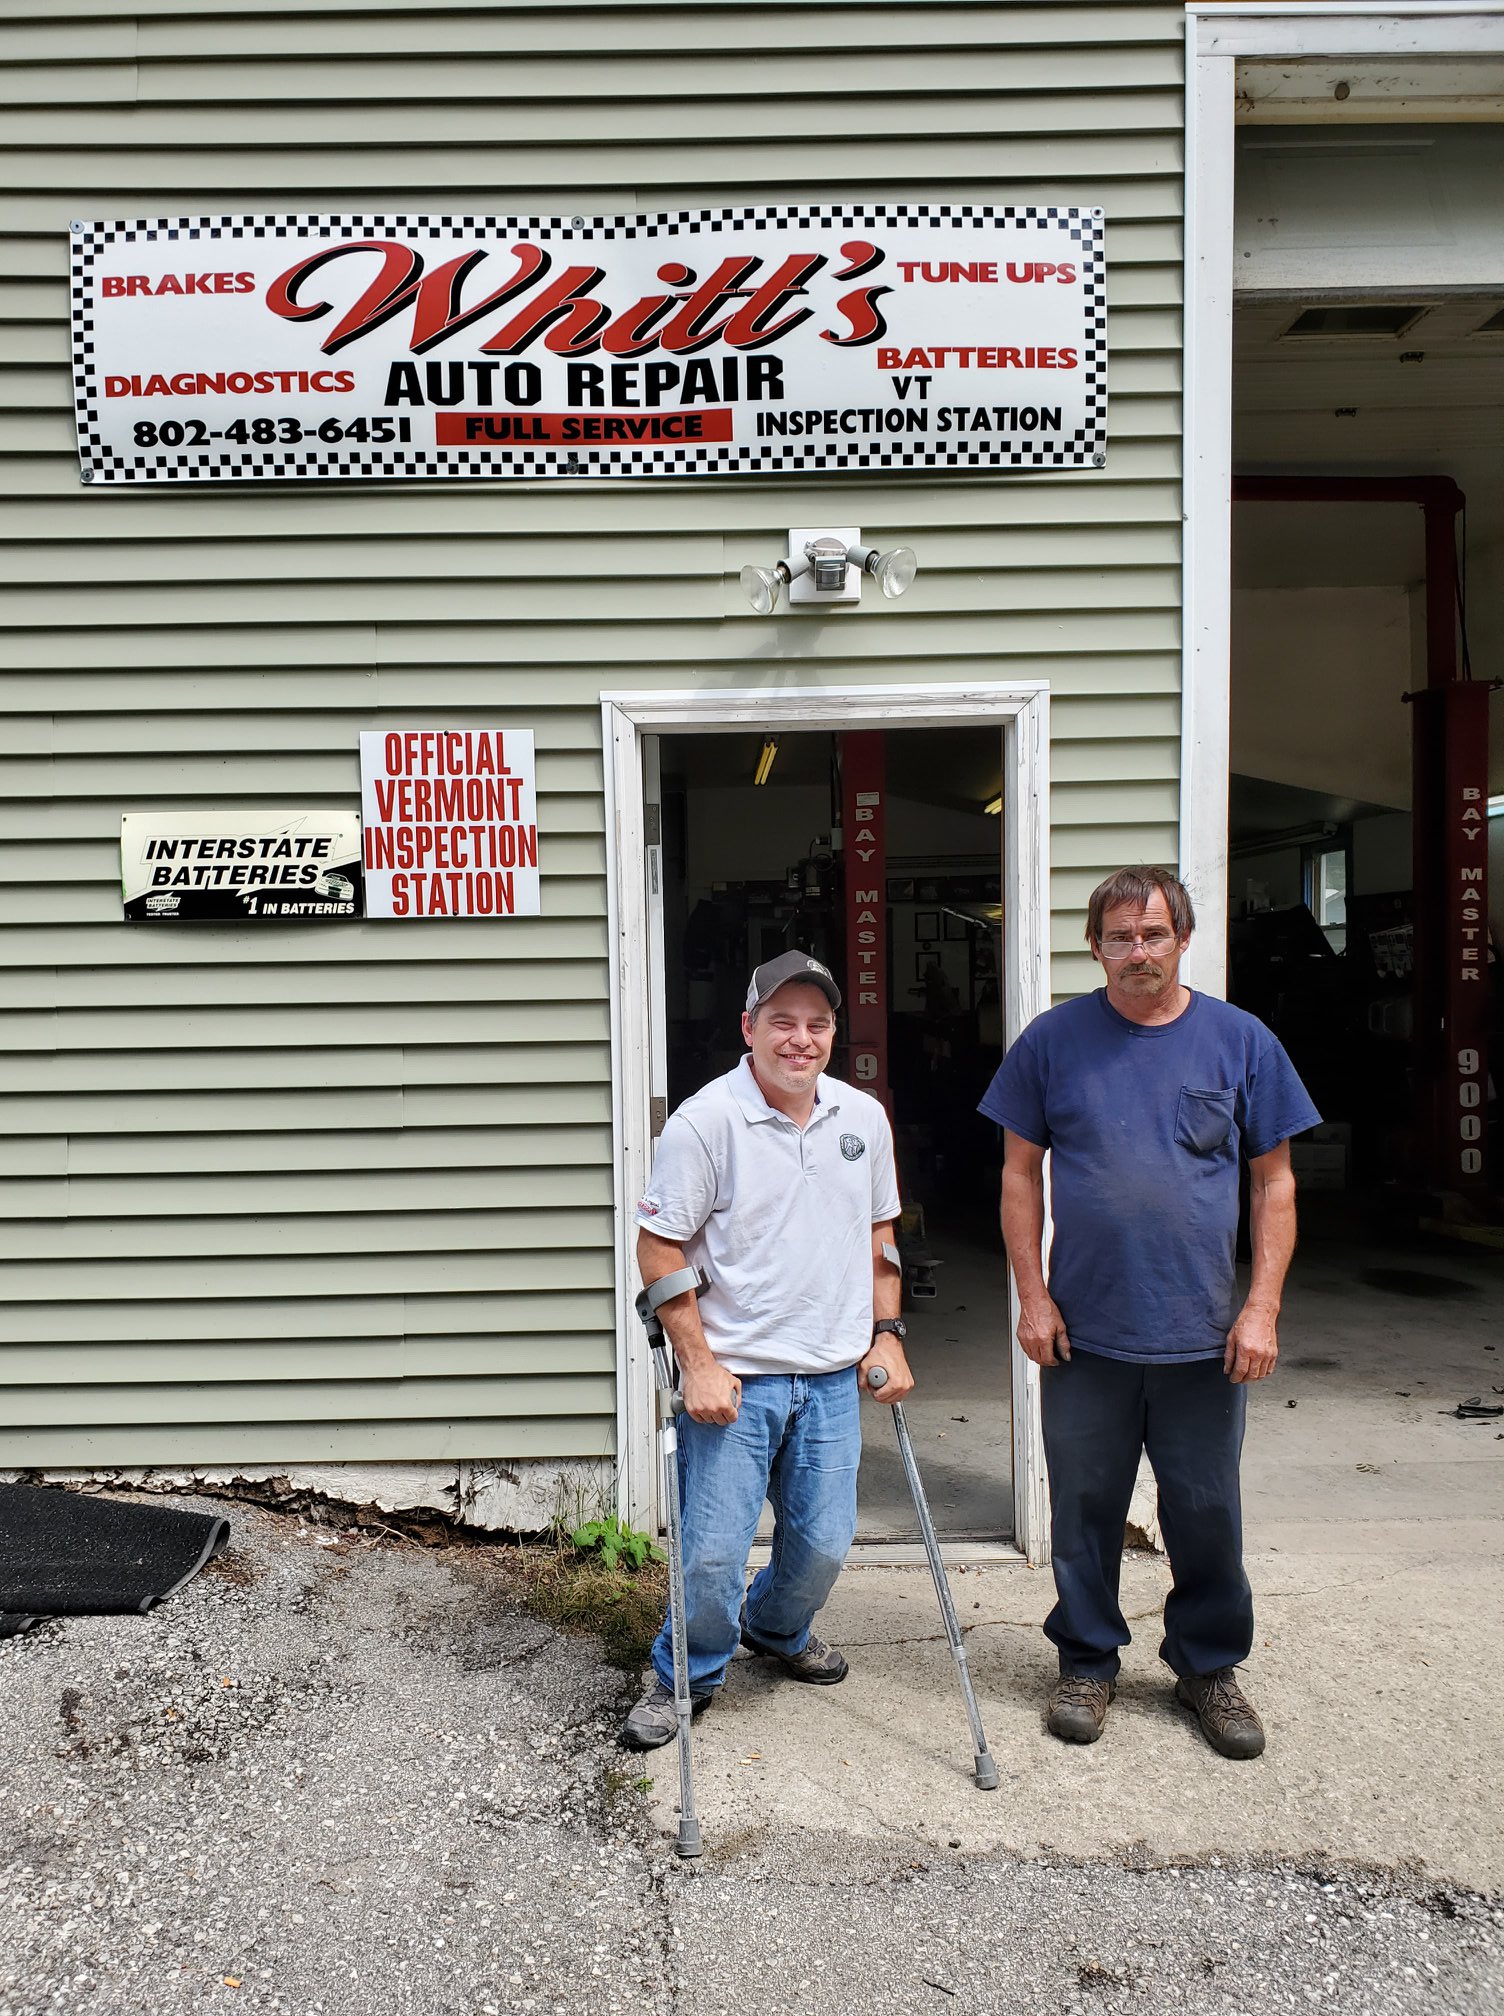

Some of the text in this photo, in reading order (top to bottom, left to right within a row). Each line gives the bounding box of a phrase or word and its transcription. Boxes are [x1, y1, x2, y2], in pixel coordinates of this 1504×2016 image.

[101, 271, 256, 298] BRAKES
[896, 261, 1077, 285] TUNE UPS
[265, 239, 895, 359] Whitt's
[876, 346, 1079, 370] BATTERIES
[103, 370, 356, 398] DIAGNOSTICS
[383, 354, 785, 408] AUTO REPAIR
[891, 375, 933, 401] VT
[132, 415, 412, 448] 802-483-6451
[465, 413, 704, 441] FULL SERVICE
[756, 406, 1062, 438] INSPECTION STATION
[384, 731, 512, 776] OFFICIAL
[374, 777, 524, 823] VERMONT
[1461, 787, 1481, 841] BAY
[145, 836, 333, 861] INTERSTATE
[365, 824, 537, 870] INSPECTION
[855, 808, 877, 862] BAY
[151, 863, 320, 887] BATTERIES
[391, 871, 515, 916] STATION
[242, 896, 355, 914] #1 IN BATTERIES
[1460, 867, 1482, 981] MASTER
[855, 890, 878, 1005] MASTER
[1457, 1048, 1482, 1174] 9000
